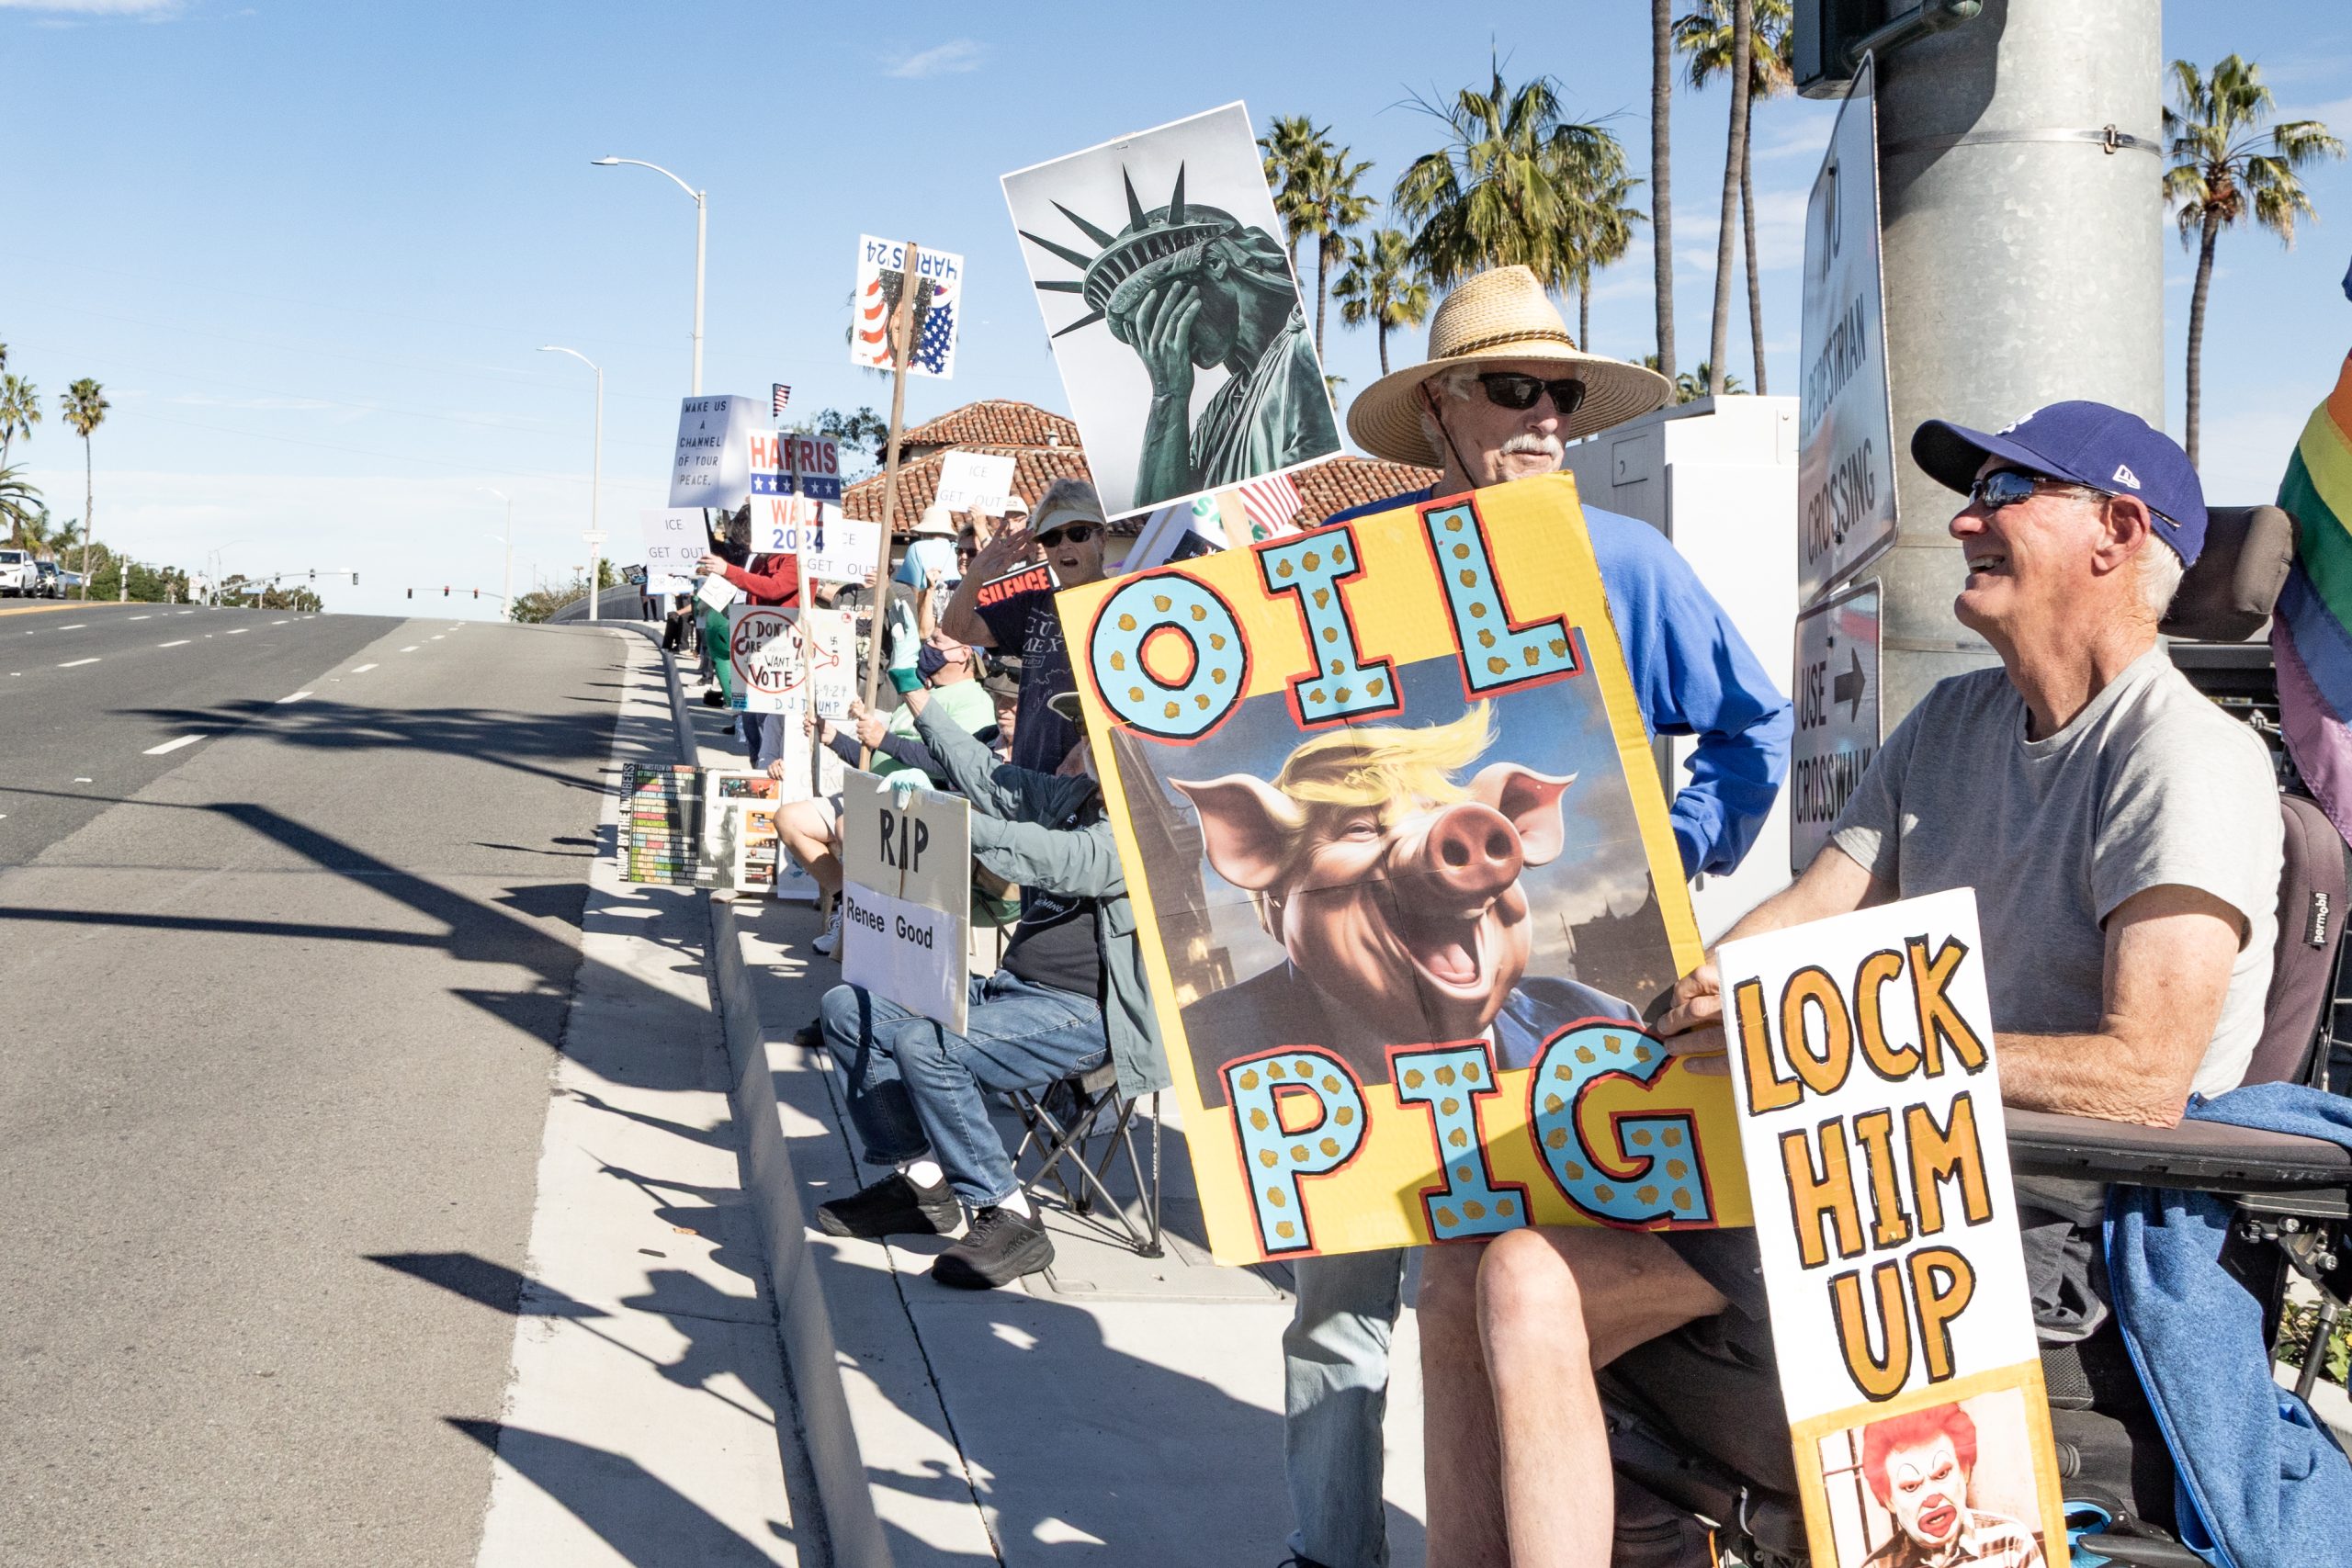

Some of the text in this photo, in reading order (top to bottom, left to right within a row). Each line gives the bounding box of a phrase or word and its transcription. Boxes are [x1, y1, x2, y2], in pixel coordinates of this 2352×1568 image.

[1807, 291, 1867, 437] PEDESTRIAN
[684, 400, 727, 412] MAKE US
[699, 420, 706, 430] A
[680, 436, 721, 448] CHANNEL
[678, 456, 718, 467] OF YOUR
[969, 465, 990, 478] ICE
[940, 489, 964, 502] GET
[974, 494, 1003, 508] OUT
[1807, 437, 1876, 567] CROSSING
[665, 519, 684, 531] ICE
[649, 547, 705, 559] GET OUT
[807, 558, 833, 572] GET
[977, 568, 1051, 606] SILENCE
[742, 620, 790, 639] I DON'T
[1084, 490, 1585, 748] OIL
[734, 637, 762, 656] CARE
[764, 655, 790, 668] WANT
[748, 663, 794, 688] VOTE
[1801, 660, 1826, 732] USE
[616, 763, 635, 882] TRUMP BY THE NUMBERS
[879, 807, 929, 874] RIP
[846, 896, 933, 950] Renee Good
[2313, 892, 2329, 943] permobil
[1734, 932, 1989, 1118] LOCK
[1217, 1017, 1719, 1262] PIG
[1778, 1089, 1995, 1270] HIM
[1827, 1246, 1977, 1403] UP
